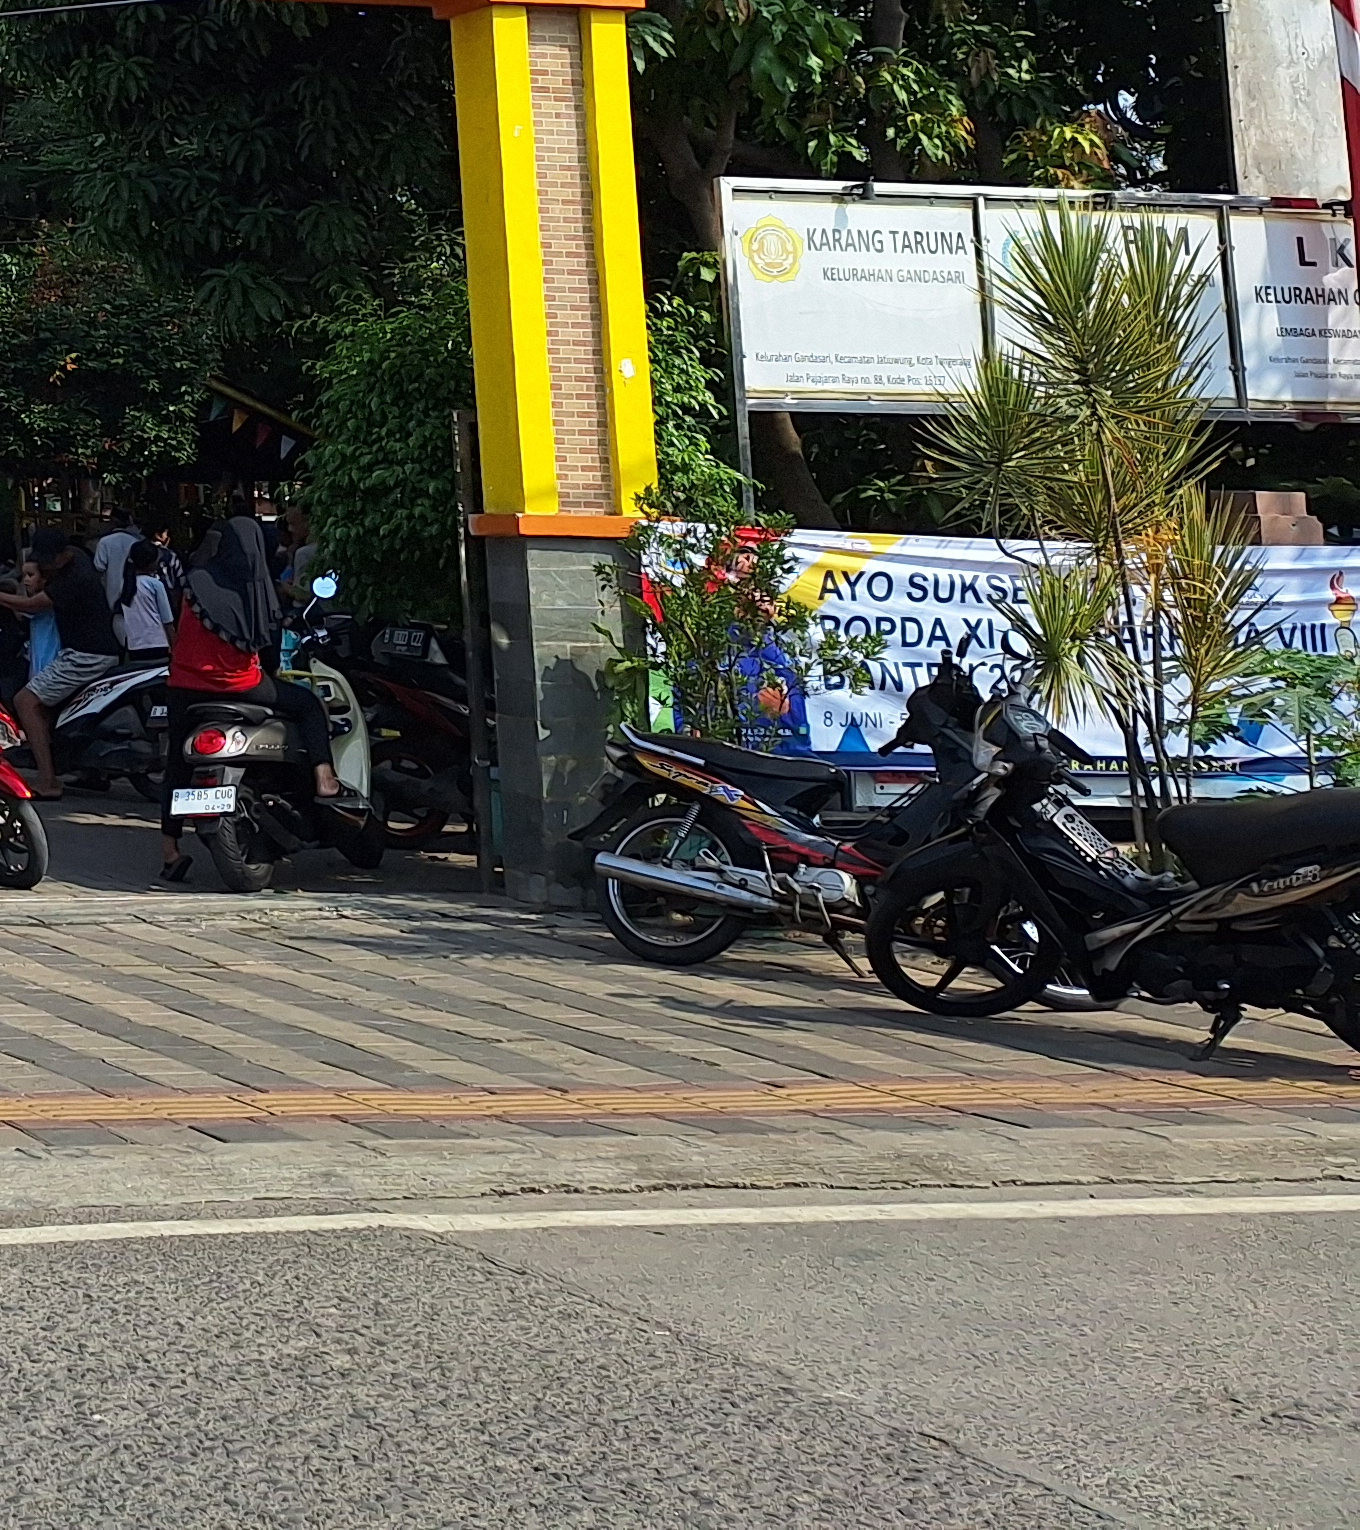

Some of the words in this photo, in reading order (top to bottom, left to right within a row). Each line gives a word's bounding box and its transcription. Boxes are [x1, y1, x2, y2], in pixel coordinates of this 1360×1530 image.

[806, 227, 884, 253] KARANG
[889, 230, 968, 255] TARUNA
[823, 266, 893, 283] KELURAHAN
[897, 269, 965, 284] GANDASARI
[1254, 285, 1349, 305] KELURAHAN
[1276, 327, 1317, 338] LEMBAGA
[818, 570, 894, 602] AYO
[906, 572, 1031, 605] SUKSE
[823, 710, 834, 728] 8
[839, 711, 882, 730] JUNI
[174, 791, 180, 802] B
